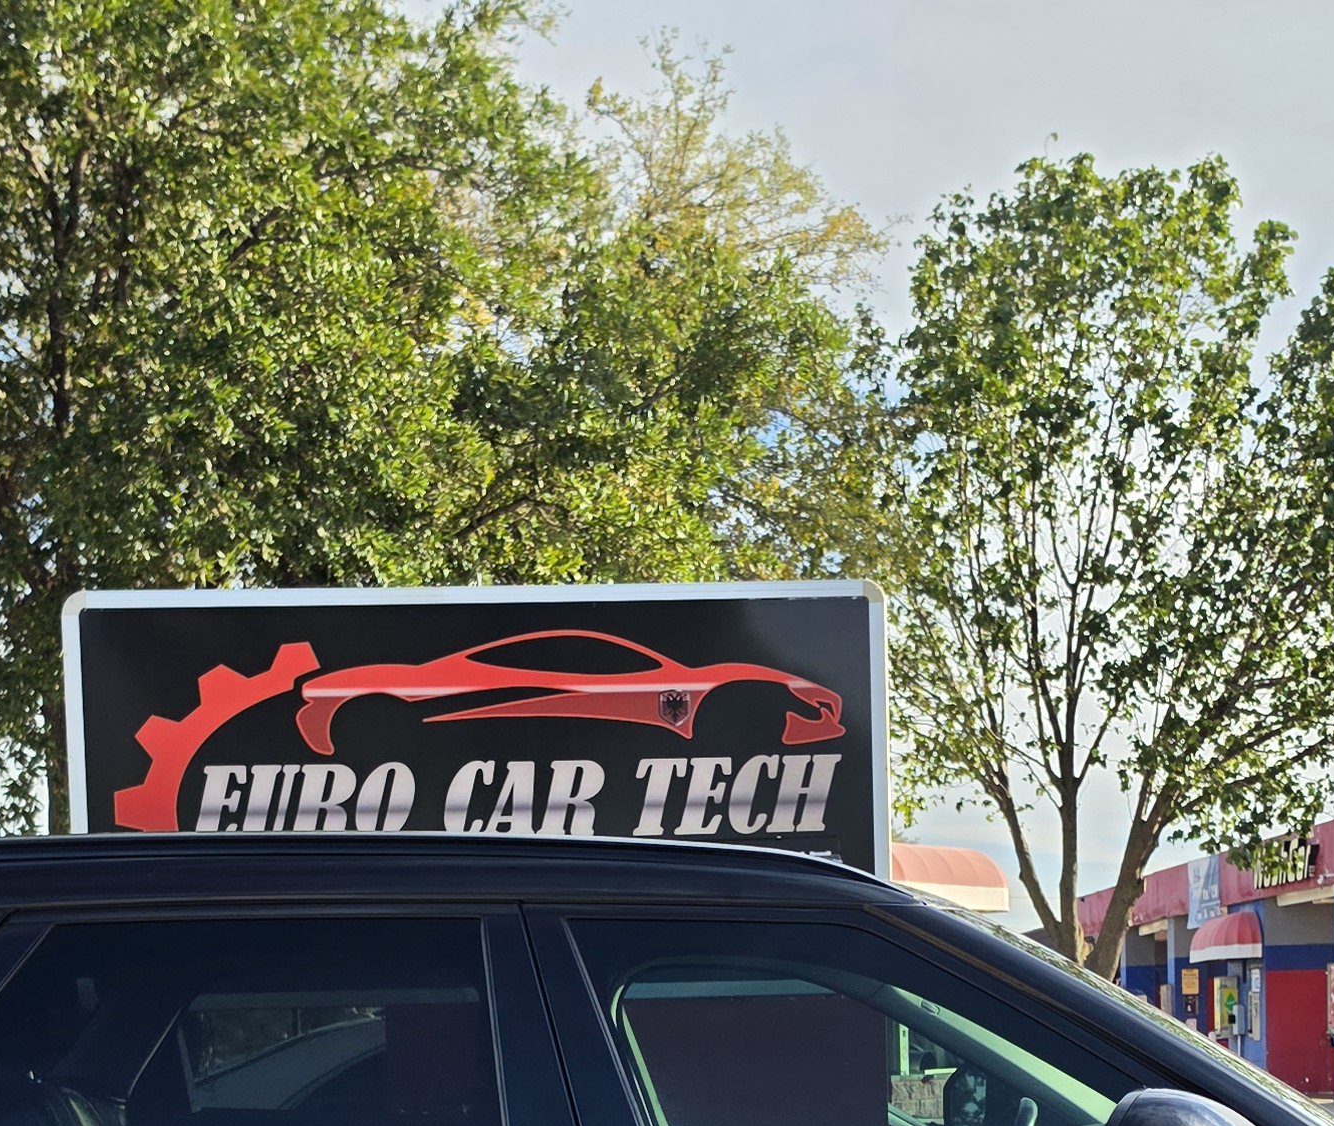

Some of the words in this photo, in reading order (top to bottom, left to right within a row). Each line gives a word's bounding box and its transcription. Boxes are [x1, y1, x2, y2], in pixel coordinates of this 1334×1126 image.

[195, 761, 416, 833] EURO
[443, 760, 606, 836] CAR
[633, 754, 842, 837] TECH
